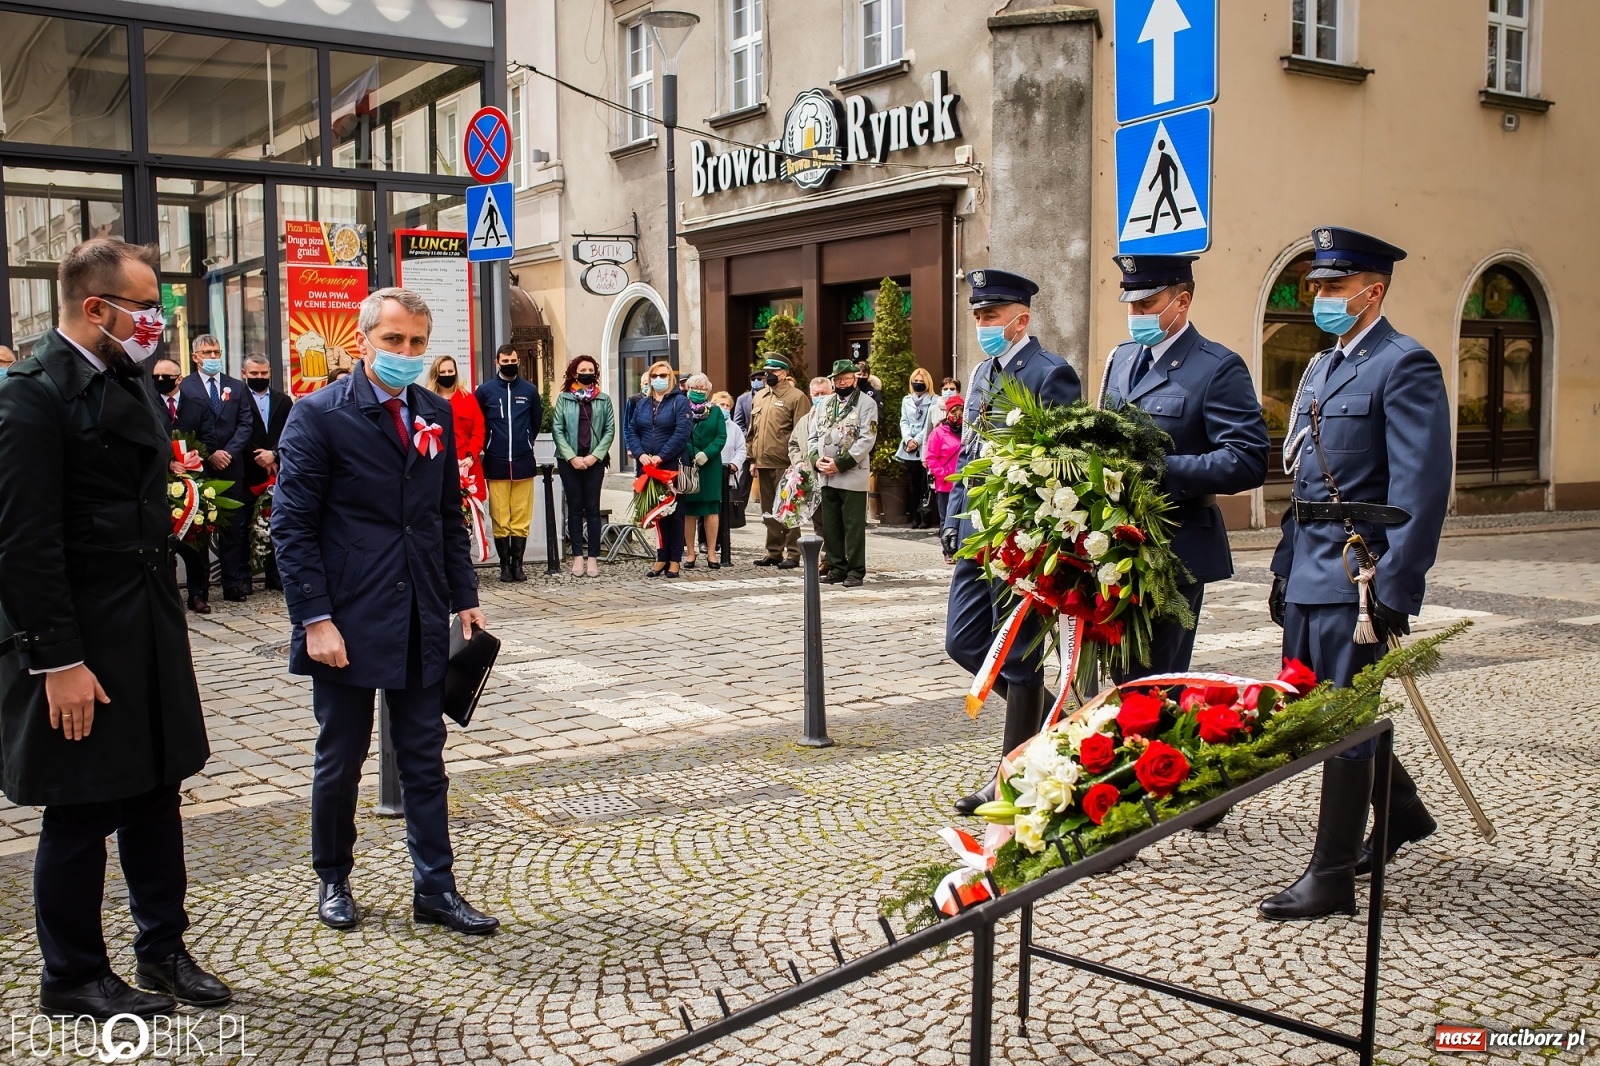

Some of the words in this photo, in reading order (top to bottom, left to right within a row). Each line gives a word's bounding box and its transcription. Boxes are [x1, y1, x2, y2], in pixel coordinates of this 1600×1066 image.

[690, 139, 783, 198] Browar
[846, 70, 958, 168] Rynek
[786, 158, 811, 176] Browar
[812, 148, 836, 169] Rynek
[287, 222, 303, 233] Pizza
[304, 223, 321, 234] Time
[287, 235, 308, 247] Druga
[308, 236, 324, 248] pizza
[410, 236, 459, 251] LUNCH
[297, 247, 320, 259] gratis!
[590, 244, 622, 258] BUTIK
[299, 268, 359, 290] Promocja
[308, 291, 328, 299] DWA
[329, 291, 349, 299] PIWA
[294, 300, 303, 308] W
[304, 300, 327, 309] CENIE
